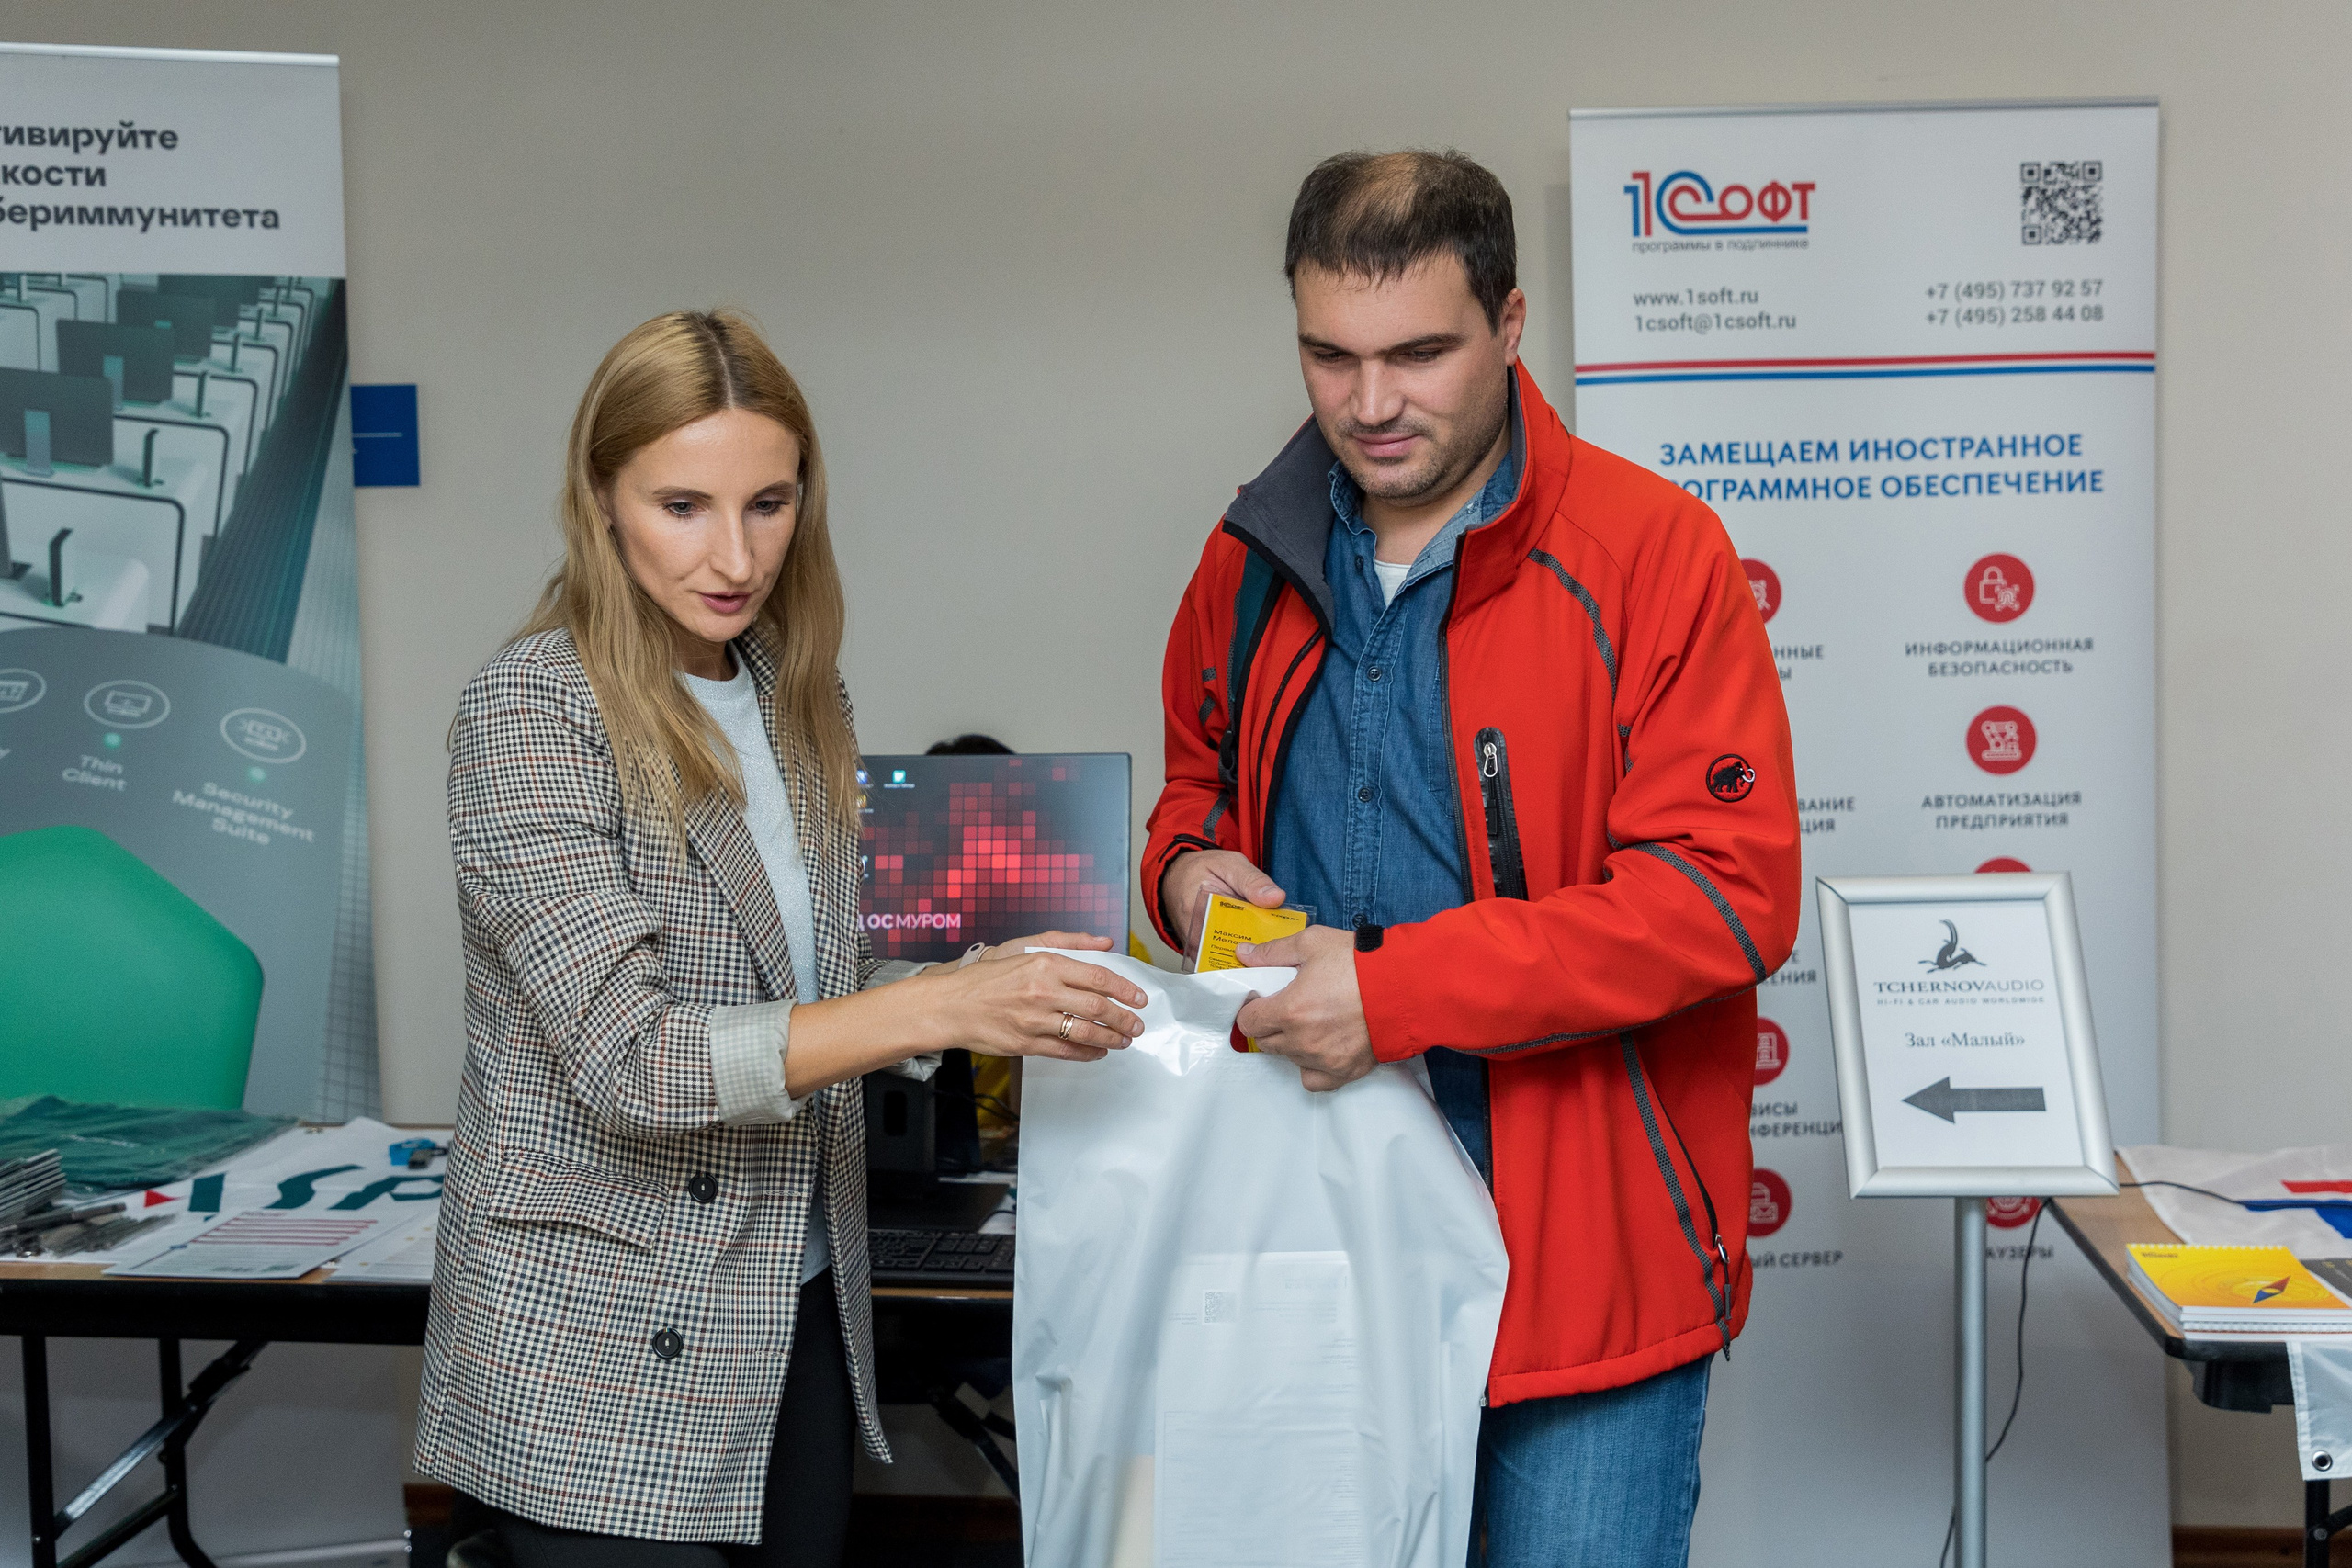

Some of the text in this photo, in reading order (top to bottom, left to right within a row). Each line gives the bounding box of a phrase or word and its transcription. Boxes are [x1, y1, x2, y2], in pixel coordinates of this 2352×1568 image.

[0, 120, 178, 154] ивируйте
[1632, 240, 1711, 253] программы
[1634, 287, 1758, 306] www.1soft.ru
[1926, 278, 2104, 303] +7 (495) 737 92 57
[1635, 311, 1797, 335] 1csoft@1csoft.ru
[1926, 304, 2104, 329] +7 (495) 258 44 08
[1659, 434, 2083, 468] ЗАМЕЩАЕМ ИНОСТРАННОЕ
[1670, 470, 2105, 502] ОГРАММНОЕ ОБЕСПЕЧЕНИЕ
[1905, 638, 2094, 656] ИНФОРМАЦИОННАЯ
[1928, 660, 2073, 677] БЕЗОПАСНОСТЬ
[62, 768, 127, 791] Client
[203, 782, 293, 819] Security
[1921, 792, 2082, 809] АВТОМАТИЗАЦИЯ
[173, 790, 314, 843] Management
[1936, 812, 2069, 829] ПРЕДПРИЯТИЯ
[212, 817, 270, 845] Suite
[896, 913, 961, 930] МУРОМ
[1213, 935, 1240, 945] Мело
[1214, 929, 1252, 941] Максим
[1905, 1032, 2025, 1047] Зал «Малый»
[1780, 1250, 1843, 1268] СЕРВЕР
